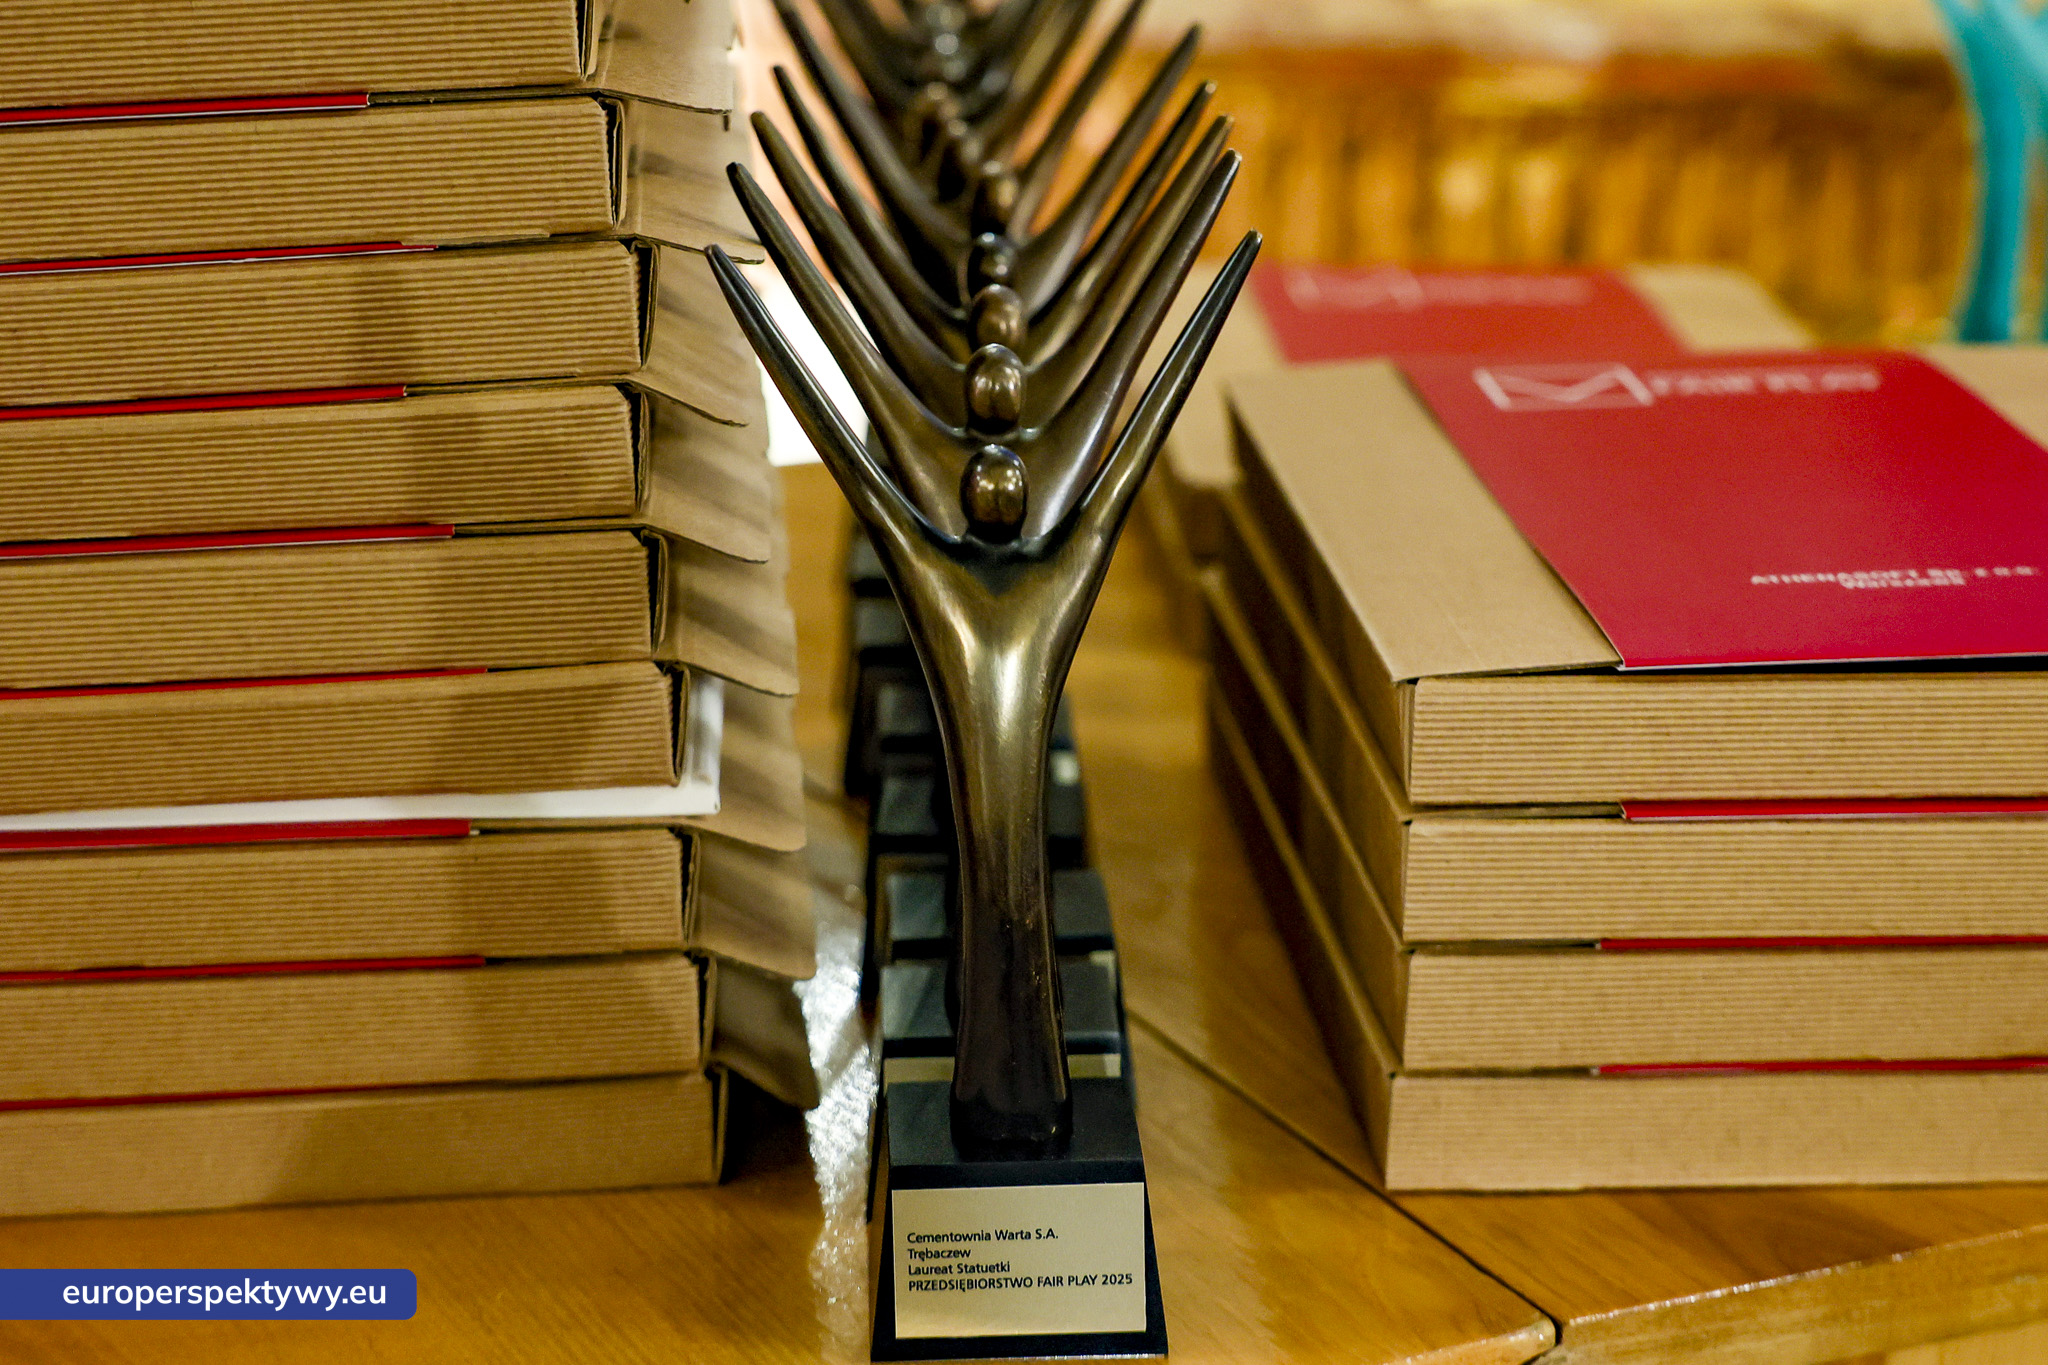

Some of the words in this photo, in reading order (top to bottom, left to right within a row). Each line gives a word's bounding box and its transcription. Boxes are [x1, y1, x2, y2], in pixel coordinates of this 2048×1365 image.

[907, 1231, 991, 1244] Cementownia
[995, 1230, 1031, 1241] Warta
[1036, 1228, 1058, 1240] S.A.
[908, 1249, 971, 1262] Trębaczew
[908, 1264, 953, 1276] Laureat
[957, 1261, 1010, 1274] Statuetki
[909, 1277, 1033, 1292] PRZEDSIĘBIORSTWO
[1037, 1276, 1063, 1287] FAIR
[1068, 1275, 1097, 1286] PLAY
[1102, 1274, 1132, 1285] 2025
